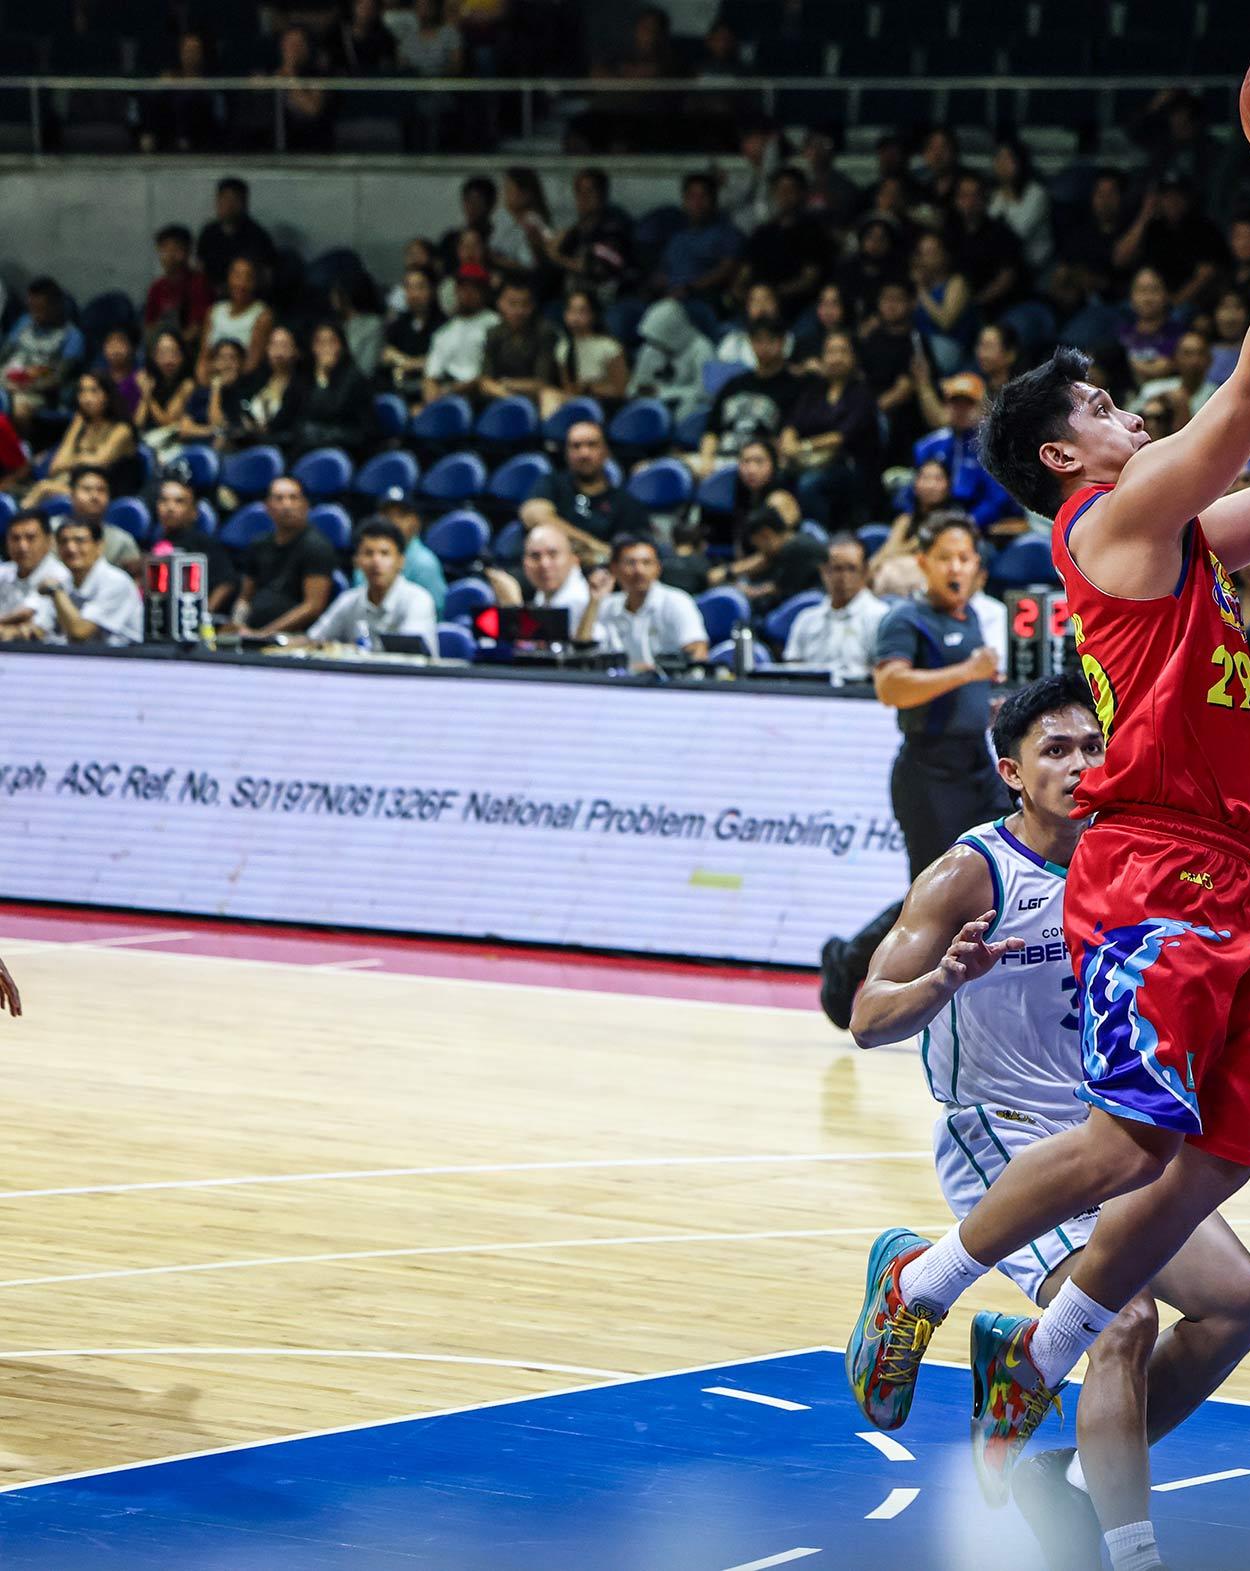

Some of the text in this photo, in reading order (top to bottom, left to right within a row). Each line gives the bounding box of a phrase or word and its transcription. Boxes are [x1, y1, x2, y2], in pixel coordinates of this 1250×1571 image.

[55, 760, 121, 797] ASC
[120, 764, 175, 802] Ref.
[179, 769, 221, 806] No.
[463, 791, 581, 831] National
[586, 800, 706, 839] Problem
[715, 808, 857, 856] Gambling
